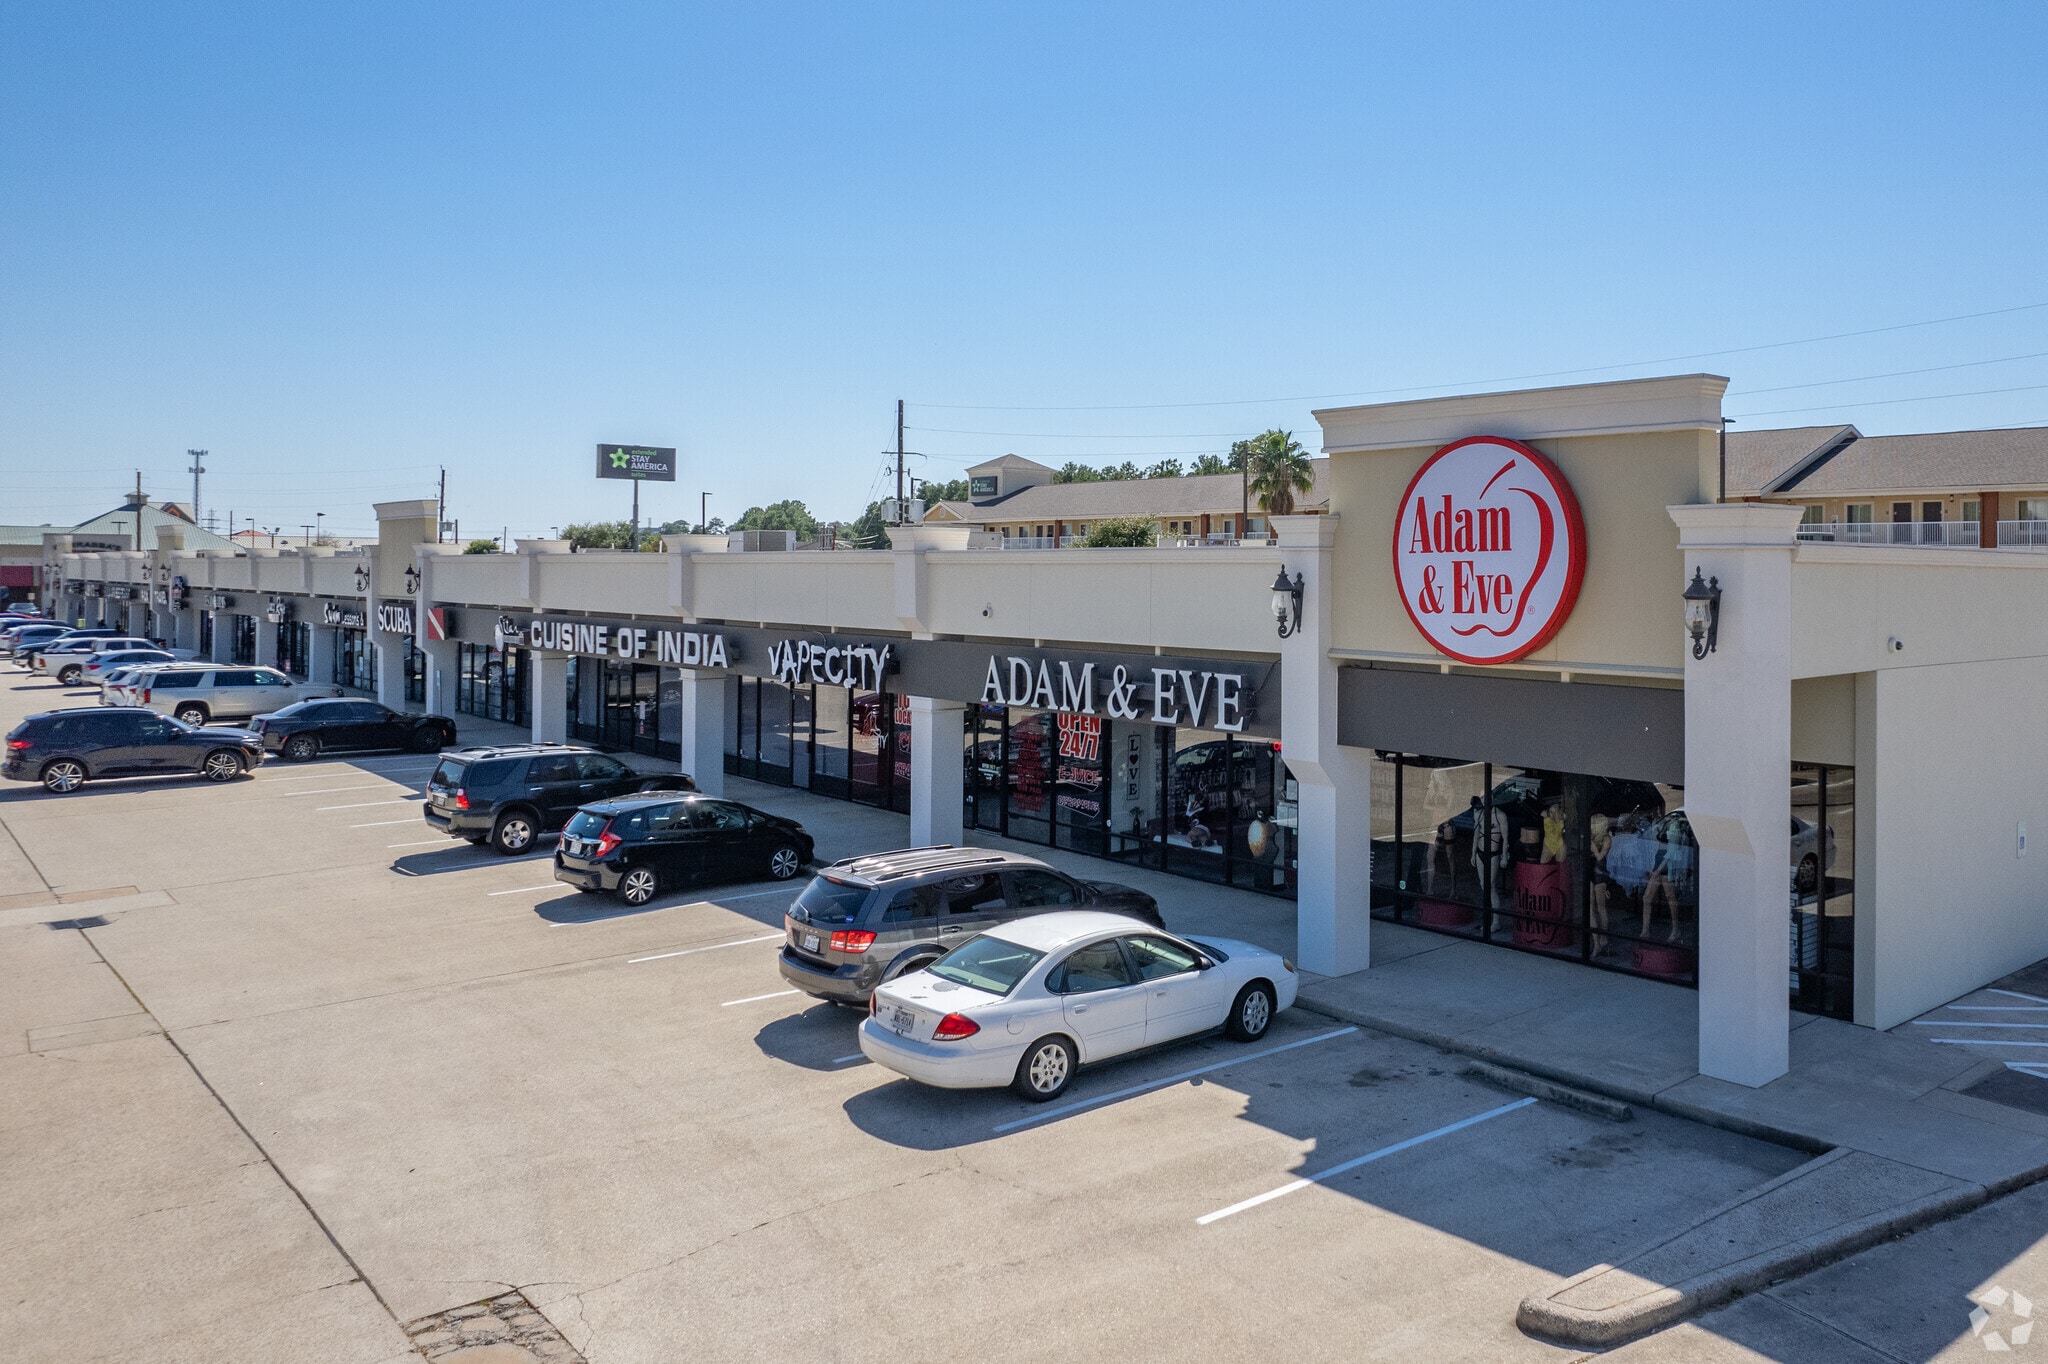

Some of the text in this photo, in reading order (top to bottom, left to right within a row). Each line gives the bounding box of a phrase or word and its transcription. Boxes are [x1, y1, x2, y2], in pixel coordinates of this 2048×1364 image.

[631, 455, 650, 463] STAY
[631, 463, 668, 471] AMERICA
[1408, 494, 1513, 554] Adam
[1418, 560, 1513, 615] & Eve
[378, 605, 413, 633] SCUBA
[530, 620, 729, 668] CUISINE OF INDIA
[768, 639, 890, 694] VAPECITY
[981, 654, 1245, 732] ADAM & EVE
[1057, 713, 1102, 734] OPEN
[1059, 729, 1099, 760] 24/7
[1059, 765, 1099, 787] E-JUICE
